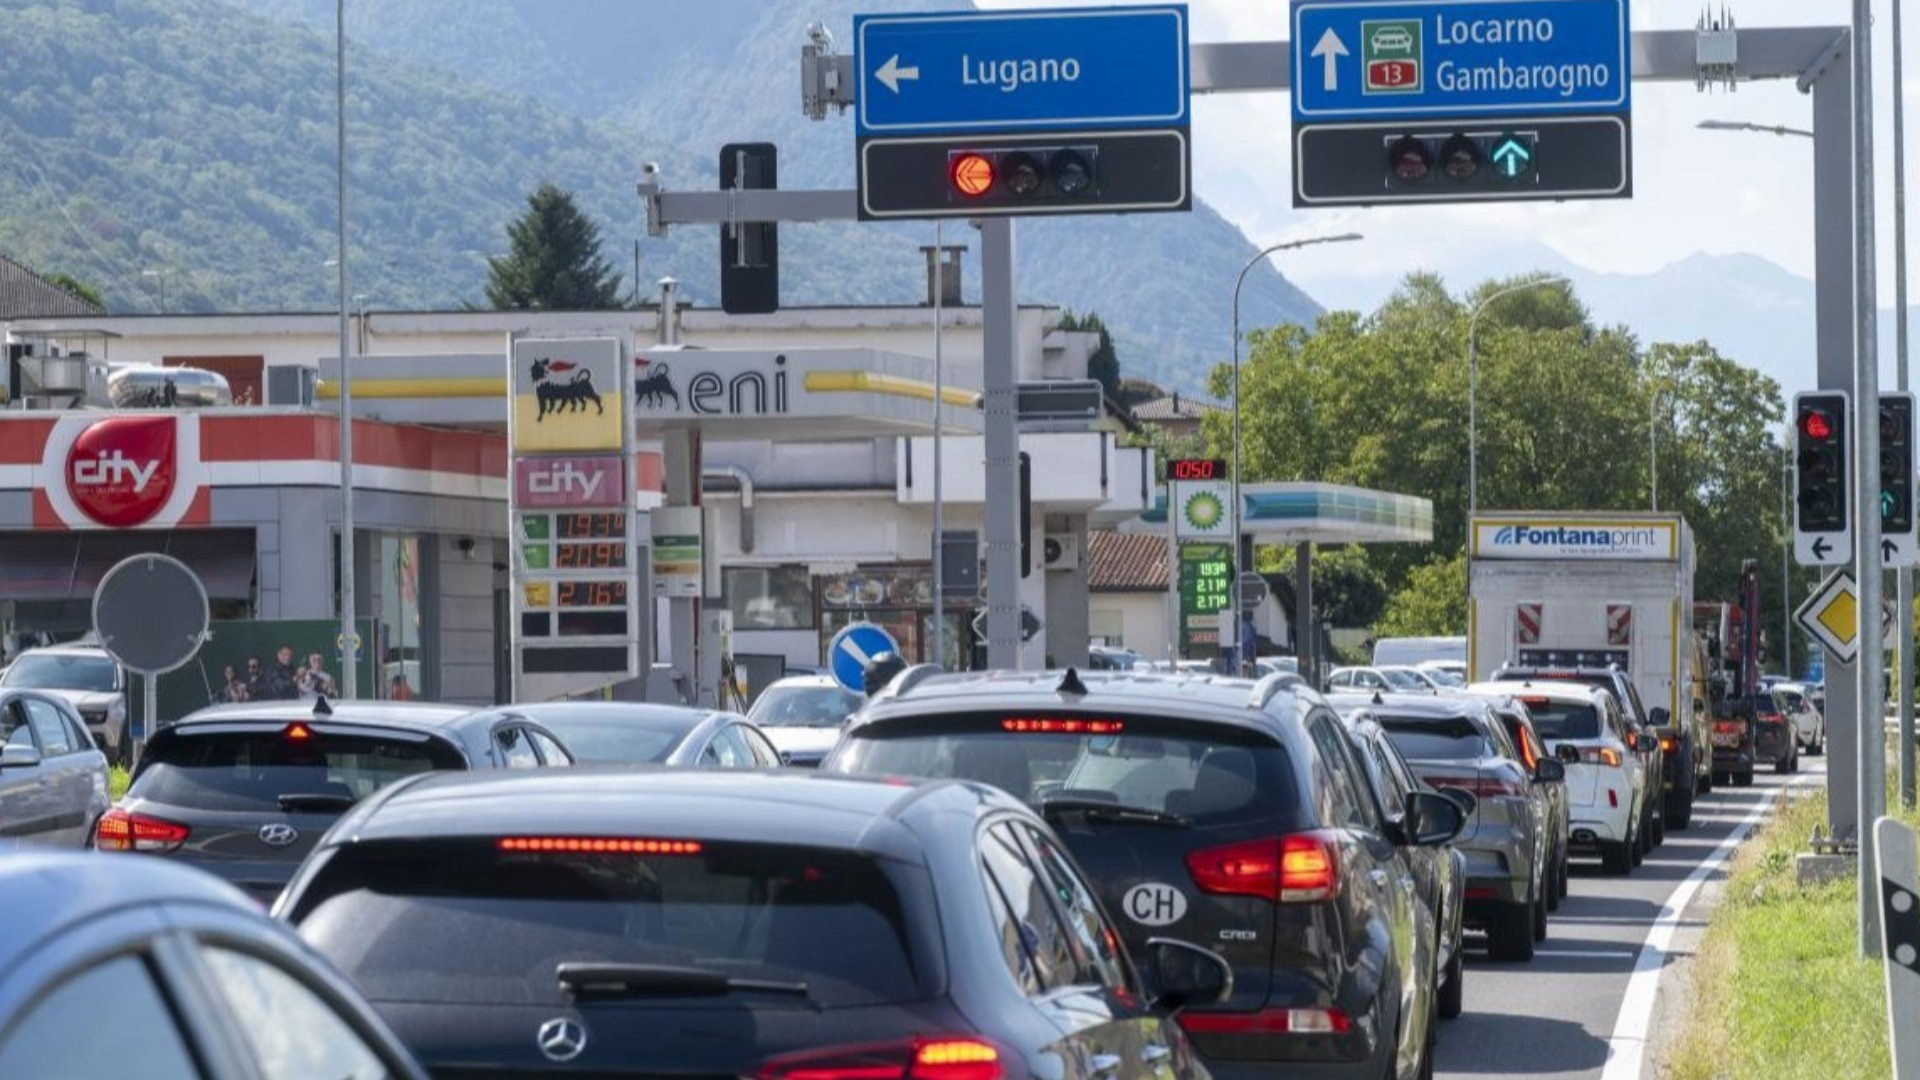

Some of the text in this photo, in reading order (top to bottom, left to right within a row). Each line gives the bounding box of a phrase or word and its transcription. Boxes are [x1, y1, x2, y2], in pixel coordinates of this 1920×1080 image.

[1437, 14, 1554, 45] Locarno
[962, 54, 1081, 92] Lugano
[1381, 64, 1402, 84] 13
[1437, 57, 1609, 96] Gambarogno
[688, 354, 787, 413] eni
[74, 449, 160, 493] city
[529, 462, 605, 500] city
[1132, 887, 1174, 920] CH
